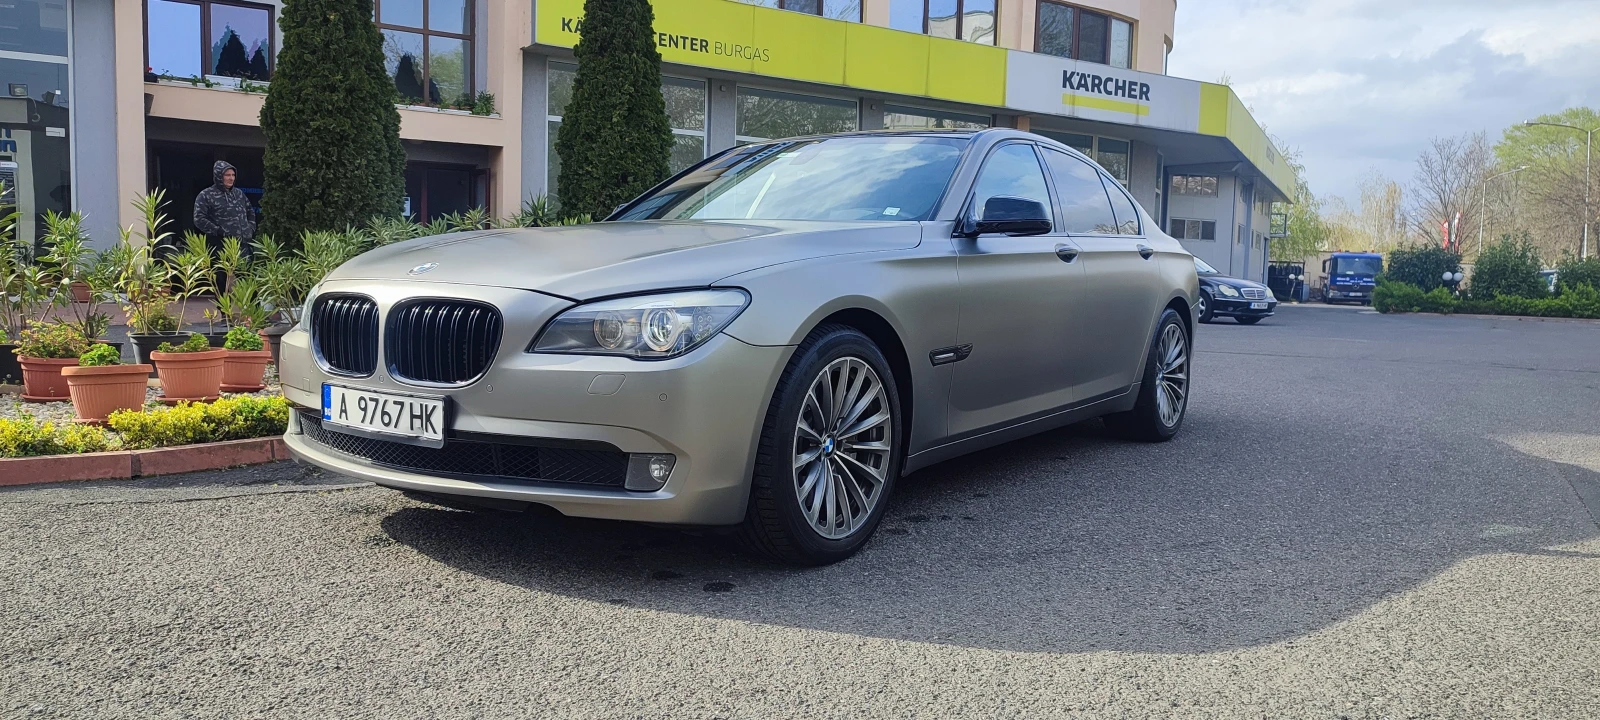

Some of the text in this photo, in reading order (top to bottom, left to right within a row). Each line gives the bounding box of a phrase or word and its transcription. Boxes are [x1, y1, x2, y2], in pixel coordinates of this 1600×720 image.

[653, 32, 770, 63] ENTER BURGAS
[1062, 69, 1150, 101] KÄRCHER
[339, 392, 348, 420] A
[357, 395, 405, 429] 9767
[409, 402, 438, 434] HK
